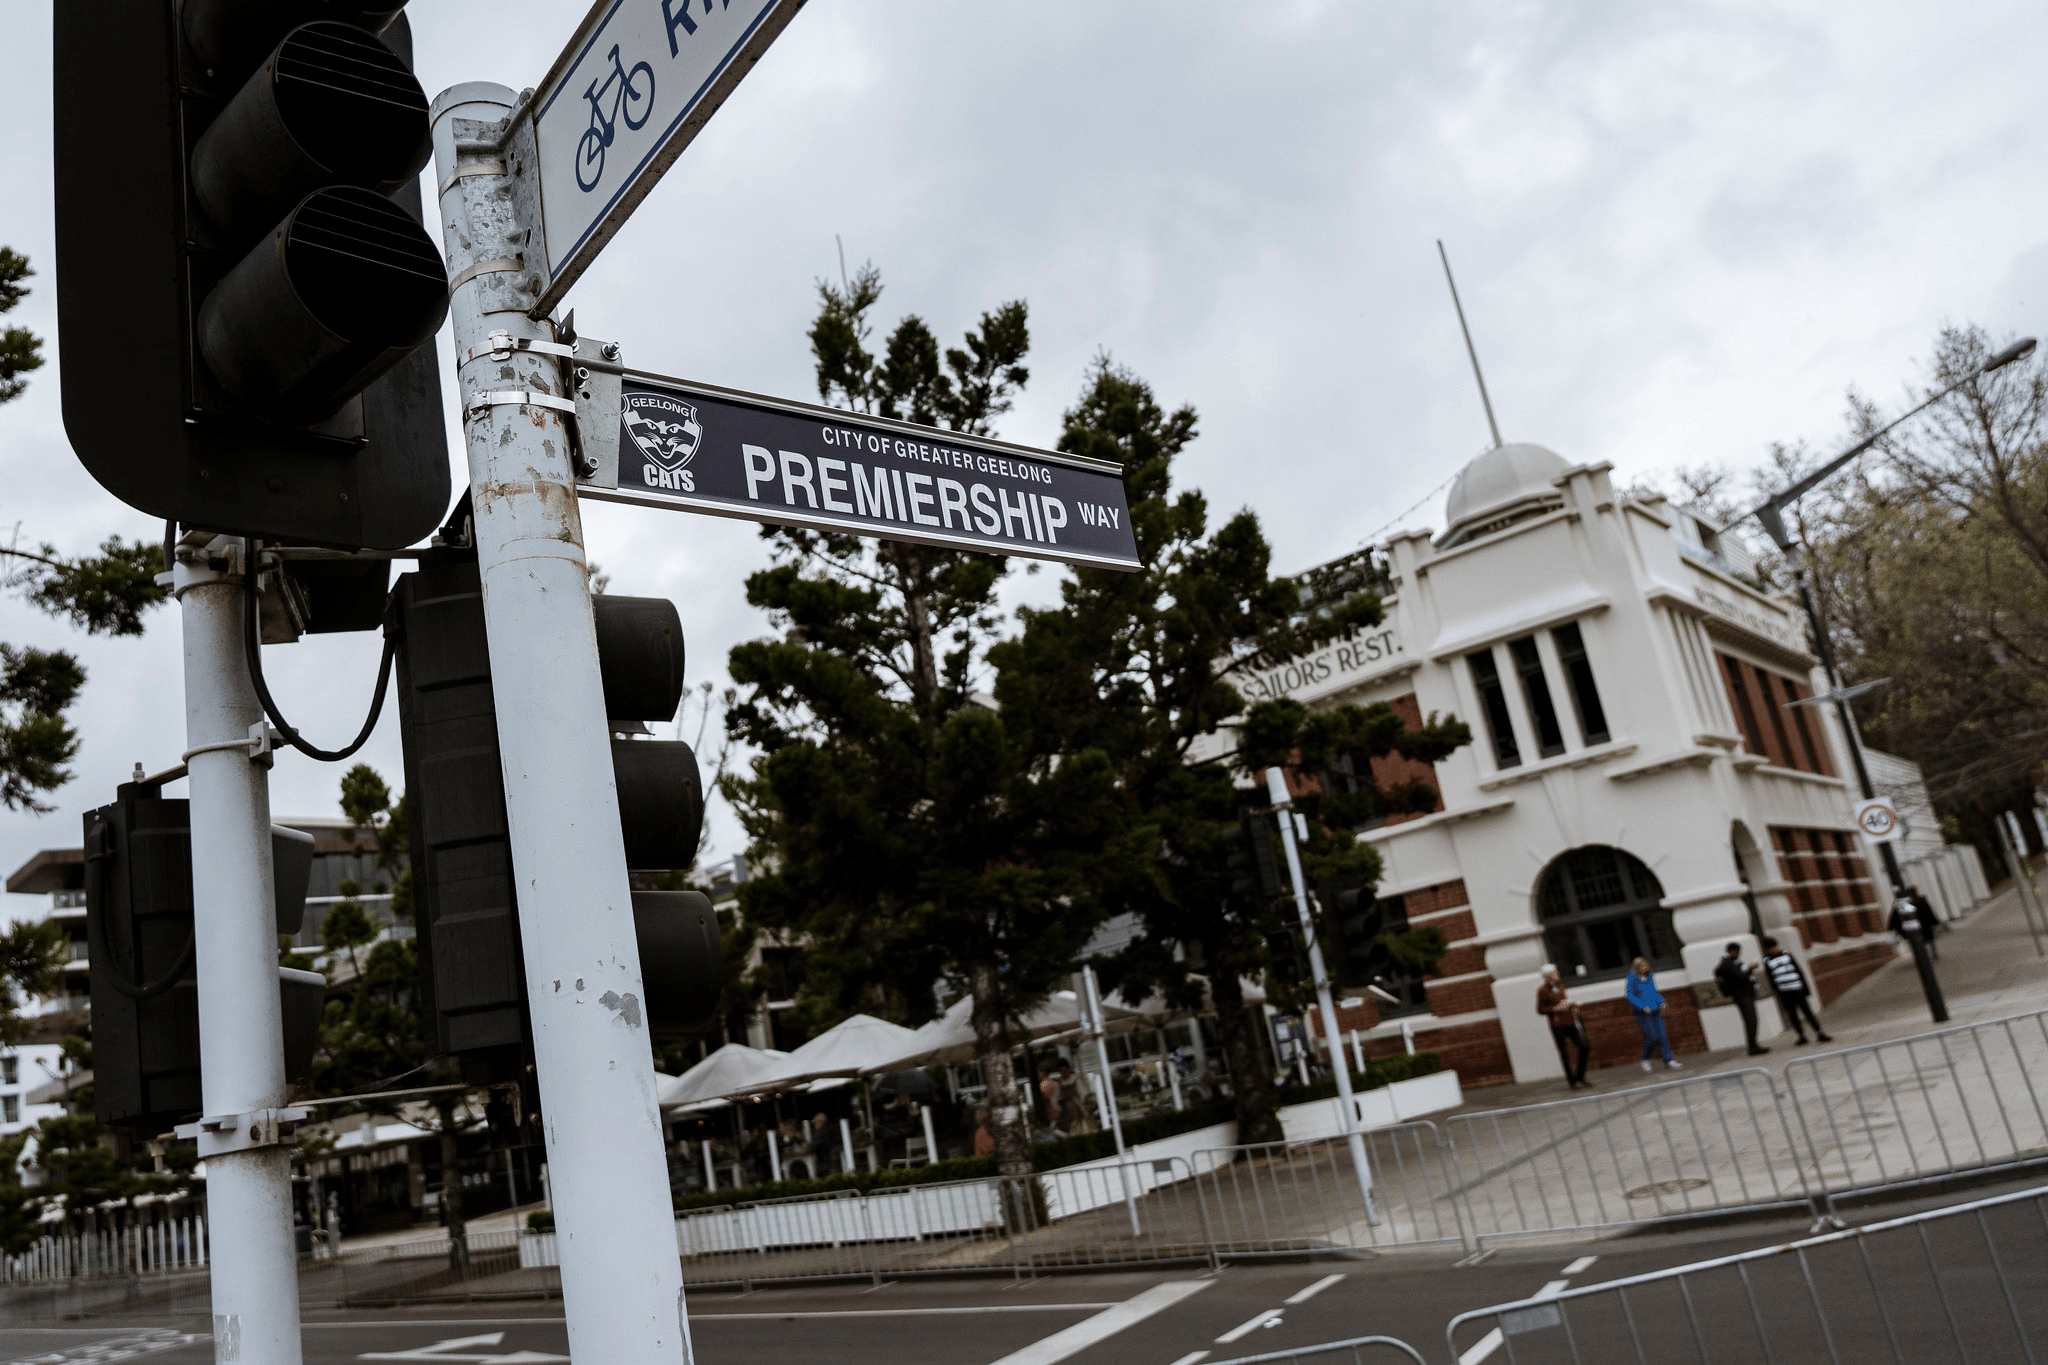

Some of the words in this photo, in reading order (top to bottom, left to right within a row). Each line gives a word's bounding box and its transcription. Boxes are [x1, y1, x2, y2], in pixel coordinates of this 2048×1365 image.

[631, 398, 690, 417] GEELONG
[822, 426, 863, 449] CITY
[867, 435, 891, 454] OF
[894, 440, 974, 470] GREATER
[976, 455, 1052, 484] GEELONG
[643, 463, 695, 492] CATS
[741, 443, 1068, 544] PREMIERSHIP
[1077, 501, 1119, 529] WAY
